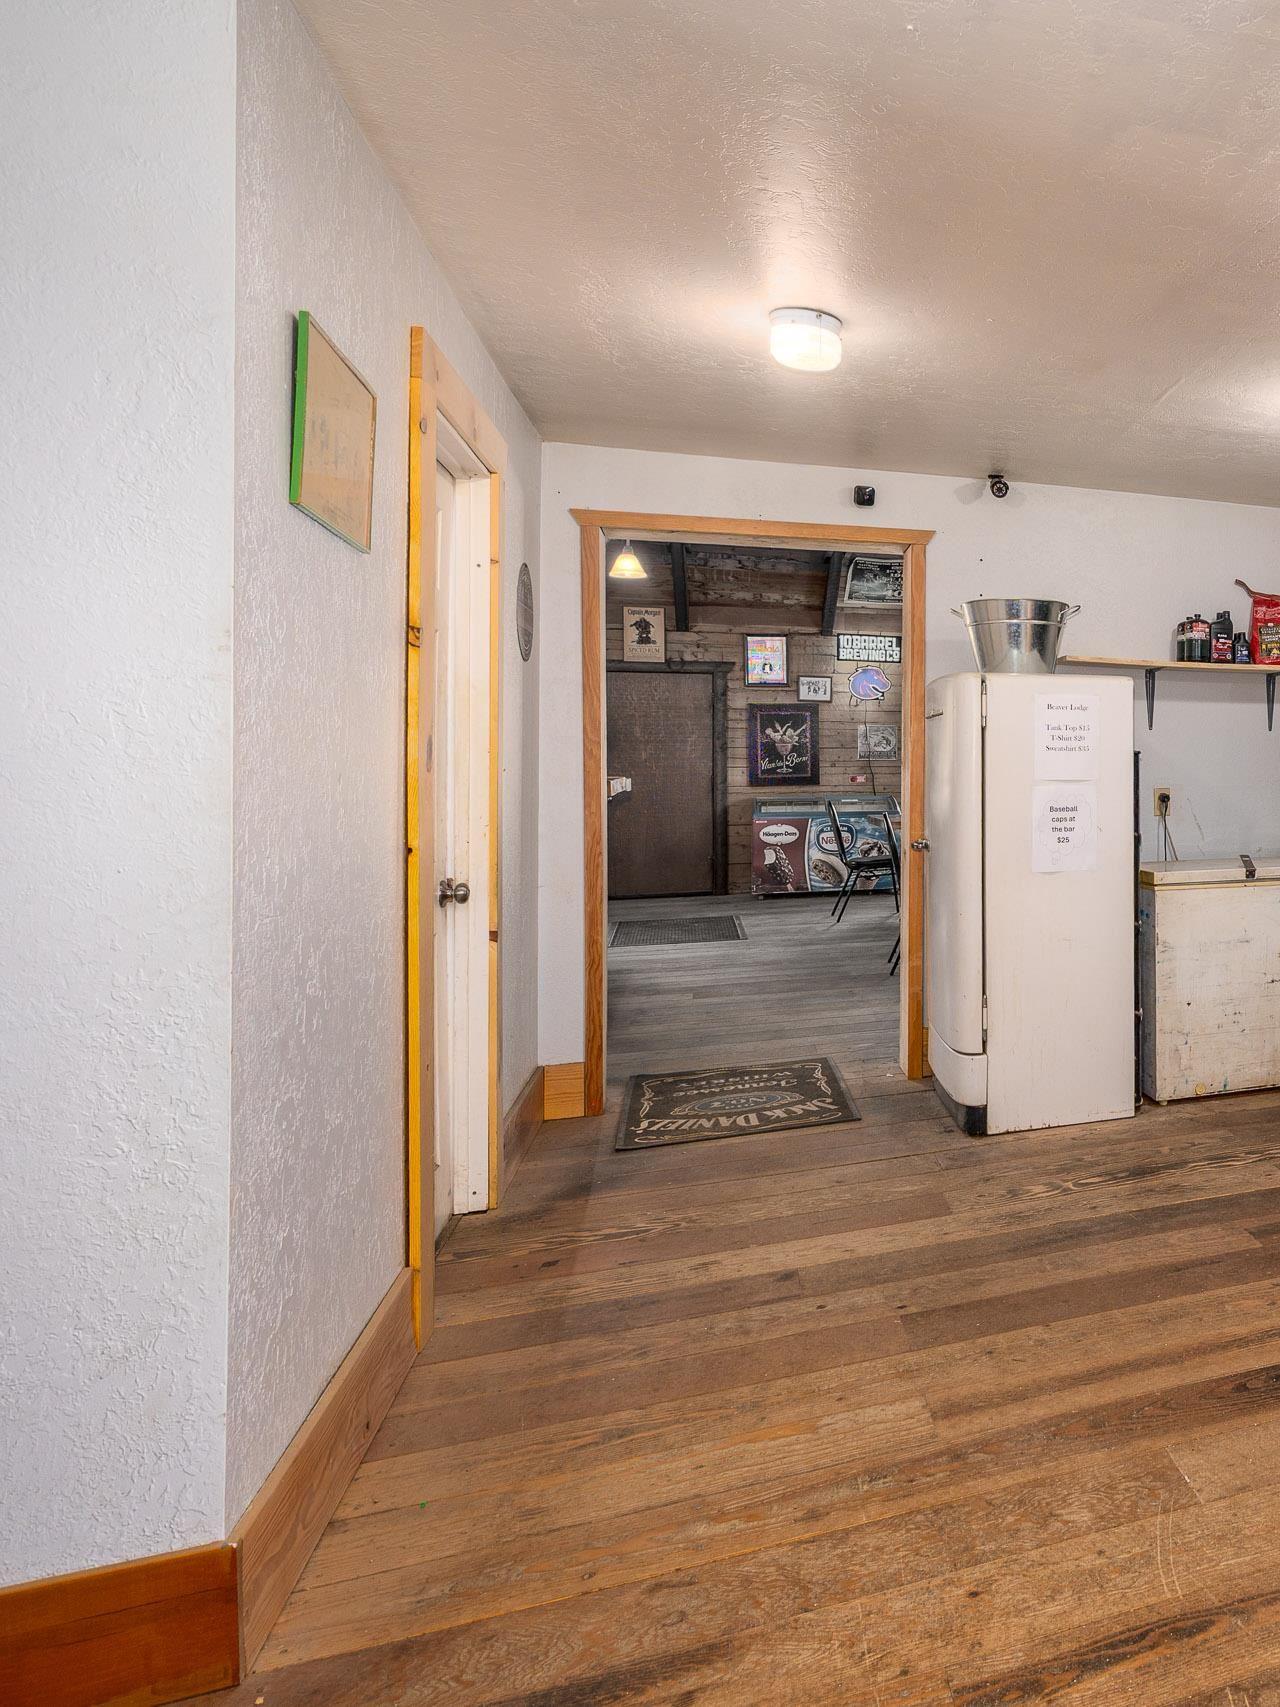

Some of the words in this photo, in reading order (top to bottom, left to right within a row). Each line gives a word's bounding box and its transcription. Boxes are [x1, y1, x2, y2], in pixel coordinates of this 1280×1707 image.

[839, 634, 852, 649] 10
[852, 635, 900, 651] BARREL
[839, 648, 886, 661] BREWING
[1070, 703, 1088, 711] Lodge
[763, 1097, 841, 1120] JACK
